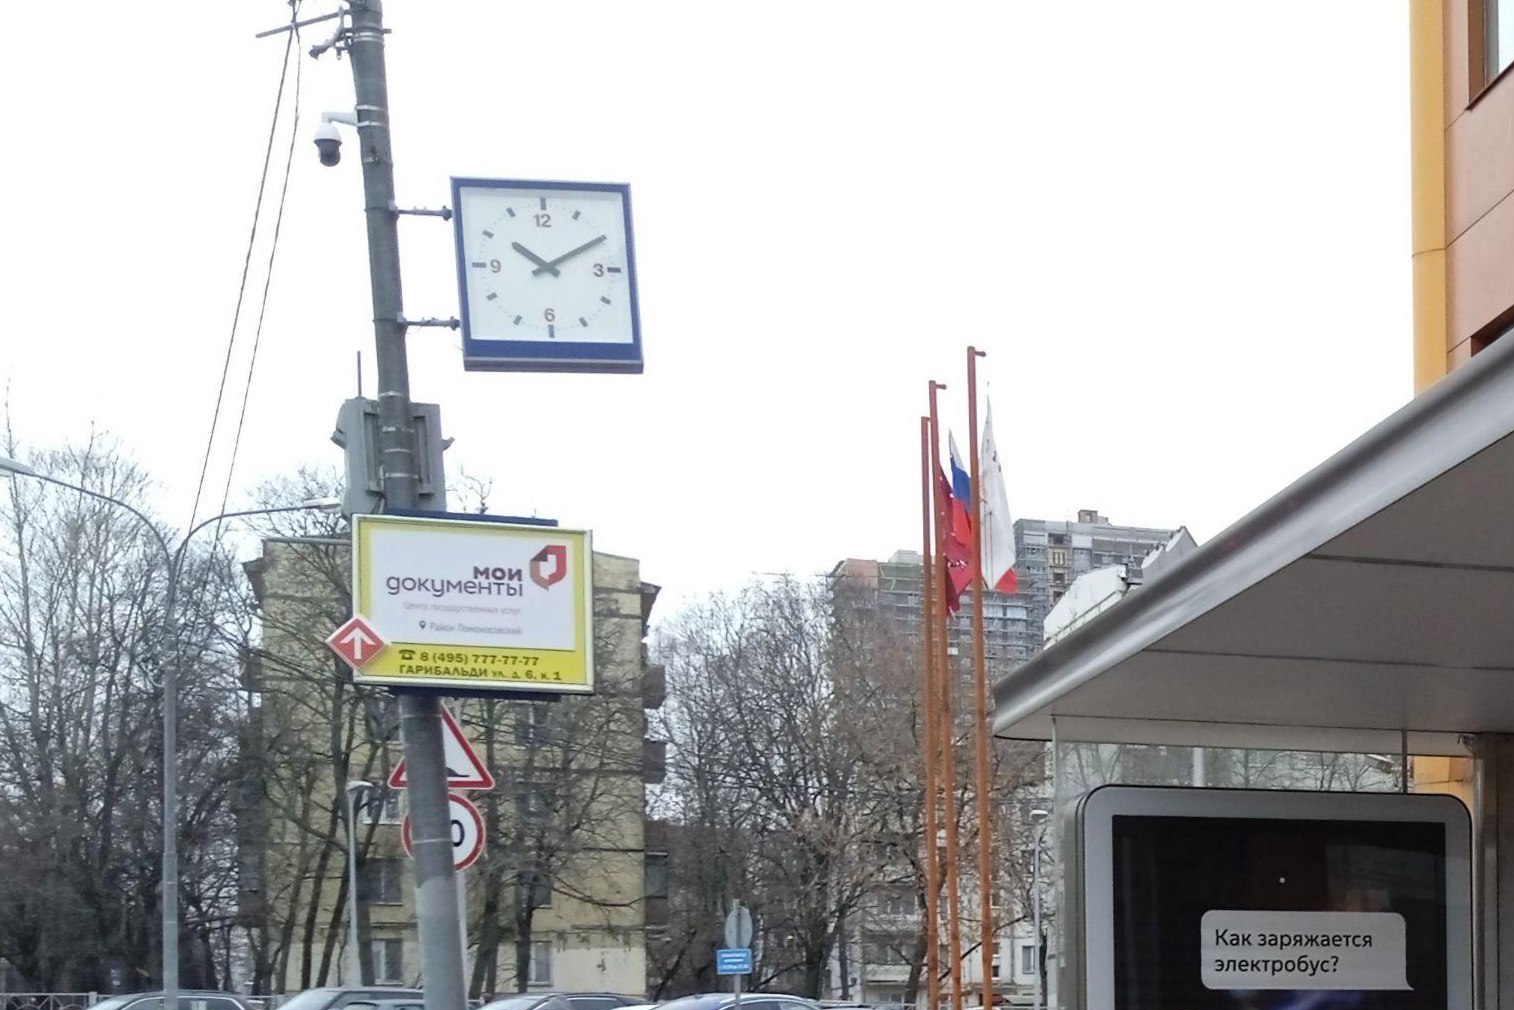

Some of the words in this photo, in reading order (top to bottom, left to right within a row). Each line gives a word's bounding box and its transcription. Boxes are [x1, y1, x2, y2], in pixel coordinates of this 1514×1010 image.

[534, 214, 552, 228] 12
[490, 259, 501, 273] 9
[593, 263, 604, 278] 3
[544, 308, 555, 322] 6
[473, 566, 523, 582] мои
[386, 576, 523, 597] документы
[420, 652, 429, 661] 8
[432, 653, 468, 665] (495)
[472, 654, 540, 667] 777-77-77
[399, 664, 488, 678] ГАРИБАЛЬДИ
[553, 671, 562, 680] 1
[1215, 929, 1252, 946] Как
[1257, 933, 1373, 950] заряжается
[1214, 955, 1339, 976] электробус?
